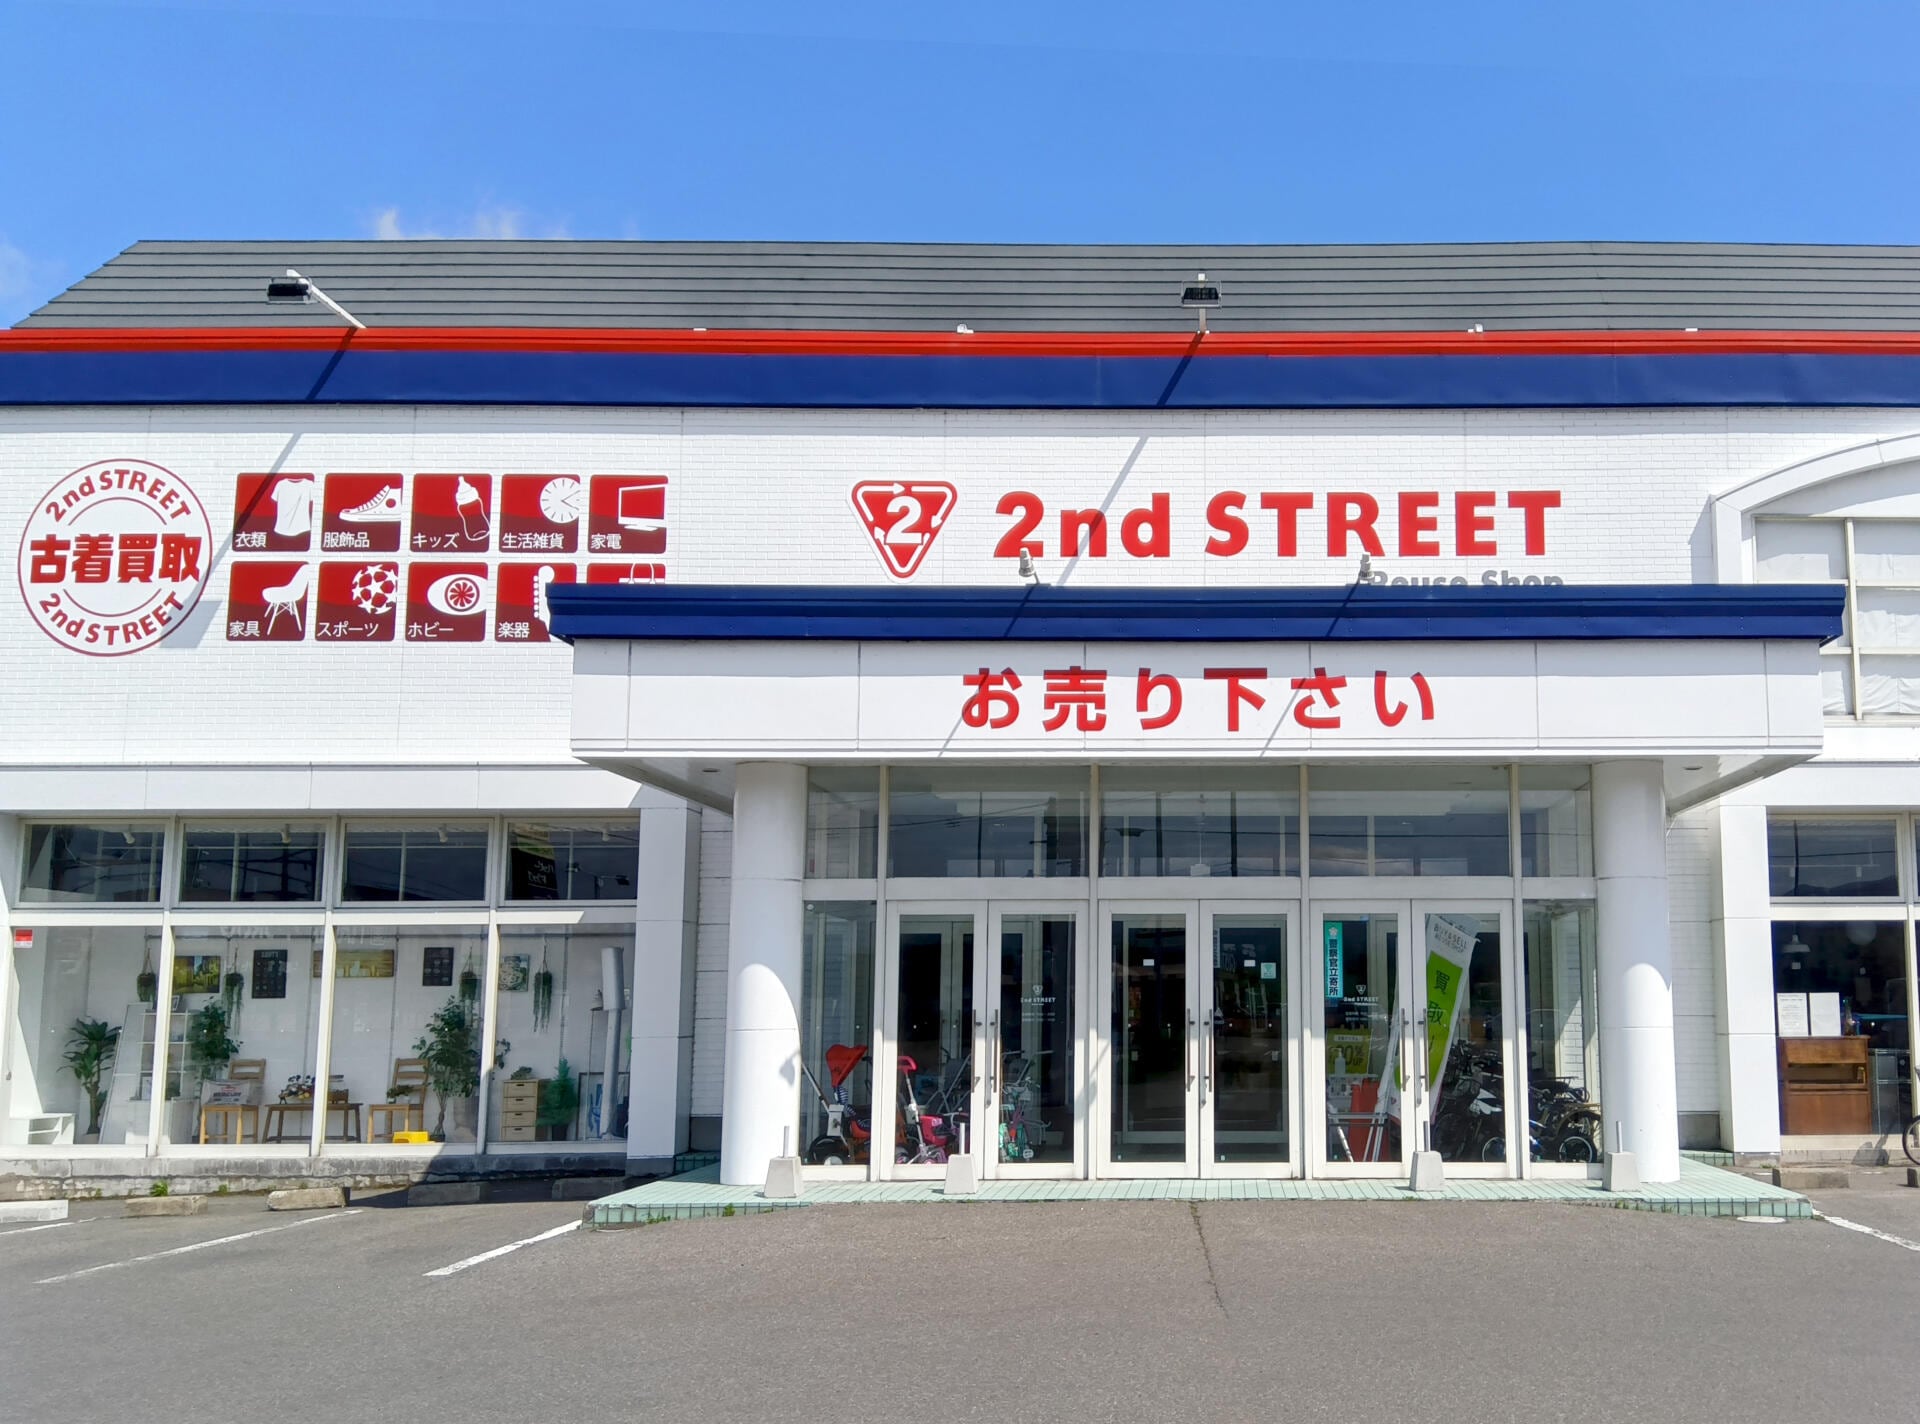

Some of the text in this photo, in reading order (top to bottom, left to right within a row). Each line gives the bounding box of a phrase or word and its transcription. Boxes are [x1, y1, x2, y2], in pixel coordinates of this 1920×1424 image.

[46, 469, 191, 522] 2nd STREET
[886, 495, 922, 543] 2
[994, 490, 1562, 558] 2nd STREET
[235, 531, 267, 548] 衣類
[322, 531, 370, 548] 服飾品
[412, 532, 460, 549] キッズ
[502, 532, 564, 549] 生活雑貨
[590, 533, 622, 549] 家電
[30, 533, 203, 584] 古着買取
[39, 591, 183, 645] 2nd STREET
[229, 620, 261, 637] 家具
[316, 620, 379, 637] スポーツ
[407, 621, 454, 638] ホビー
[498, 622, 530, 639] 楽器
[962, 667, 1435, 732] お売り下さい
